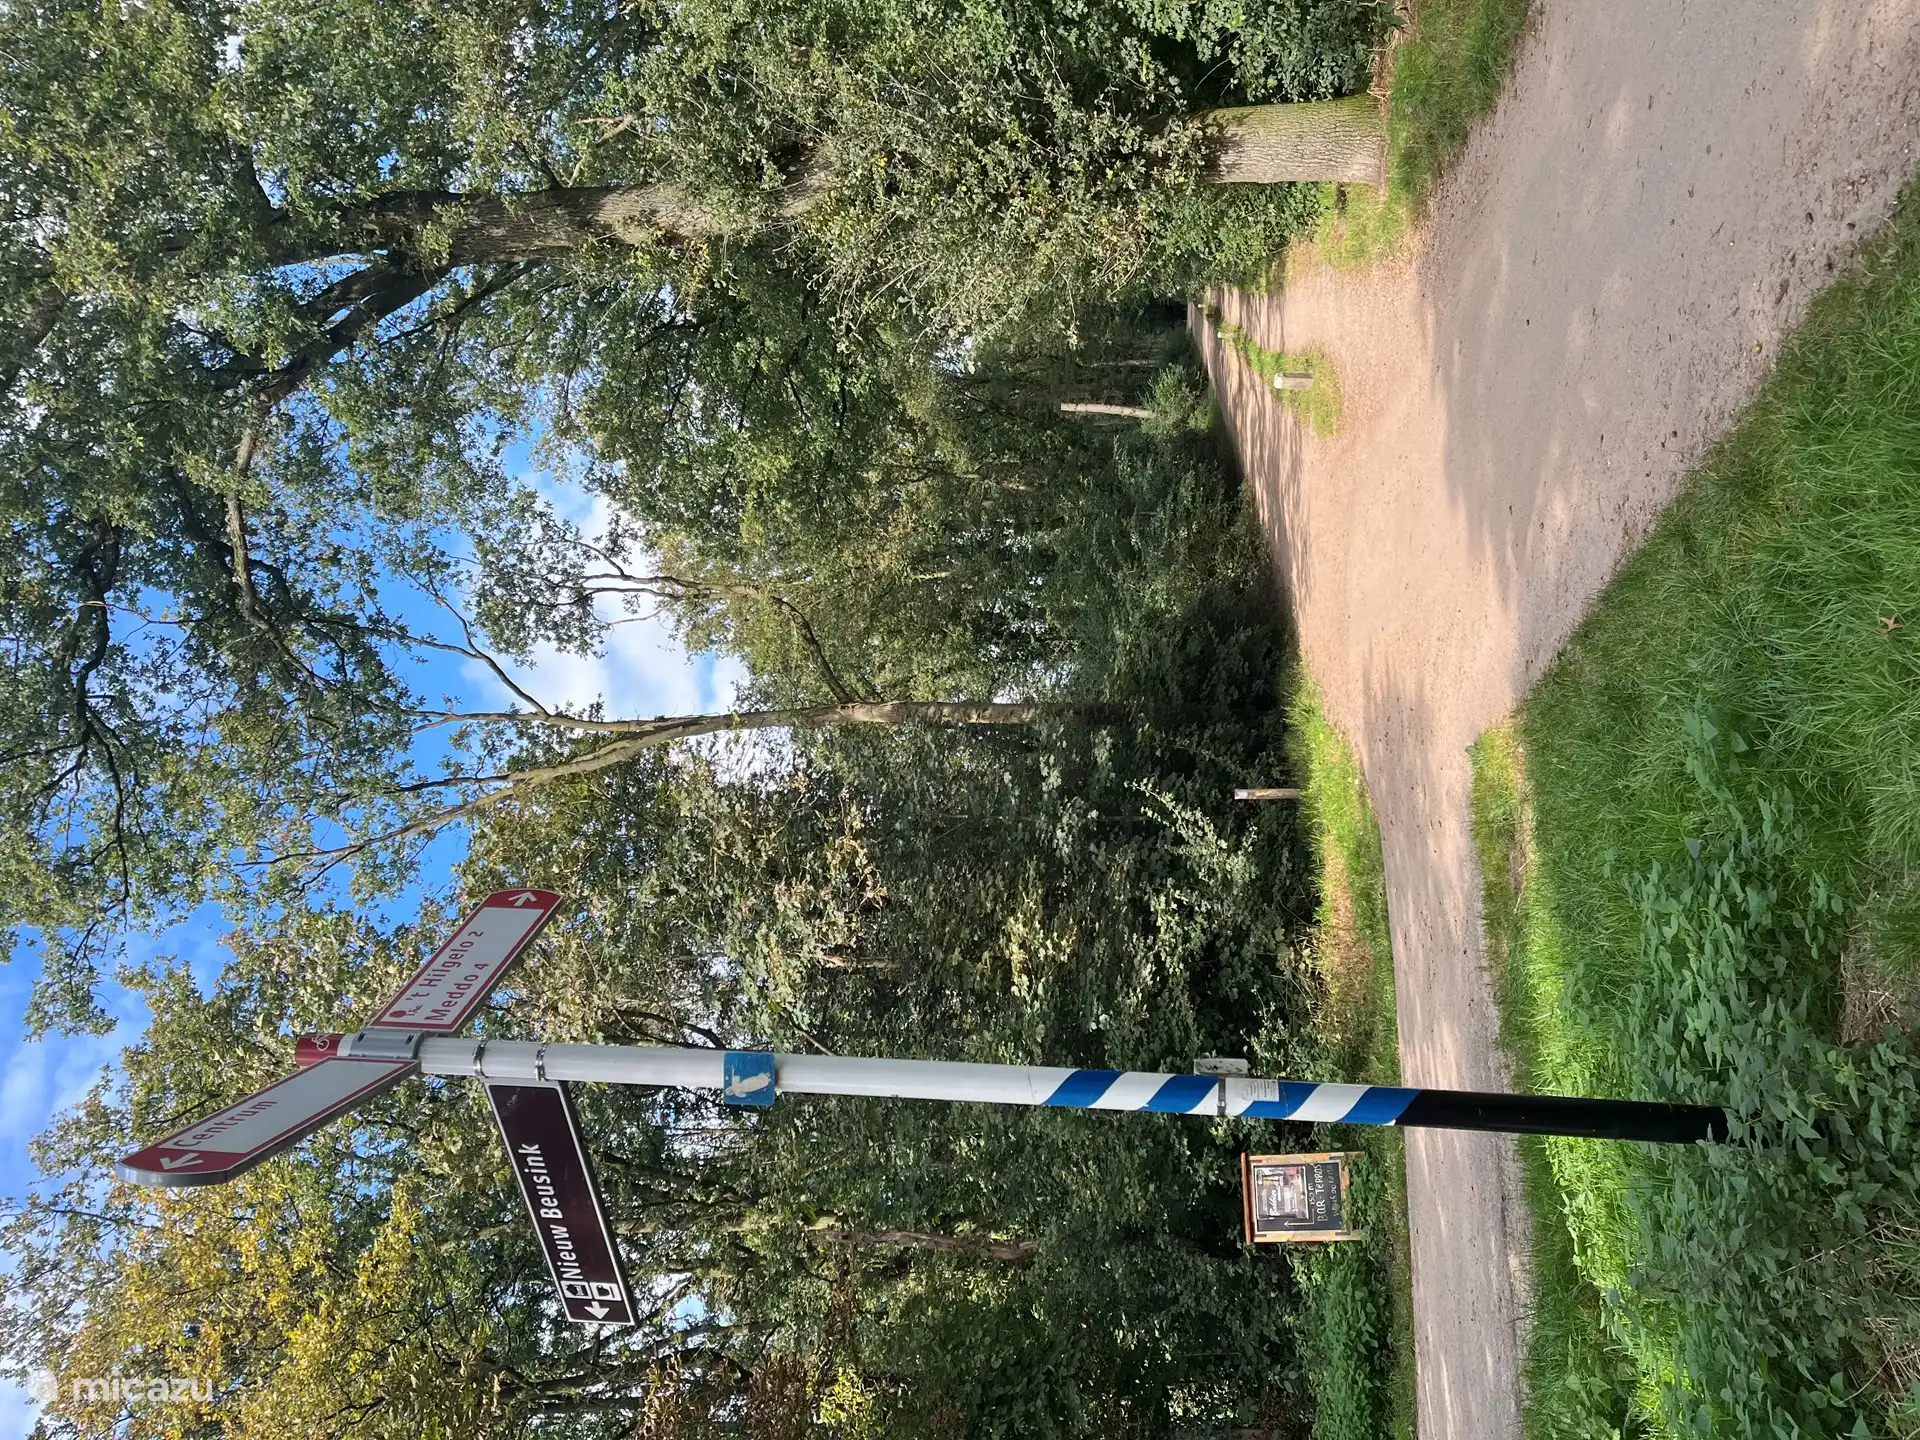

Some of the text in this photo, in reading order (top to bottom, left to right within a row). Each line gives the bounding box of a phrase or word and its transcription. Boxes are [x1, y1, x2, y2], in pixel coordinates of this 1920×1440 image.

[405, 992, 430, 1001] 't
[419, 940, 474, 987] Hilgelo
[424, 974, 479, 1021] Meddo
[173, 1100, 279, 1149] Centrum
[518, 1143, 584, 1280] Nieuw Beusink
